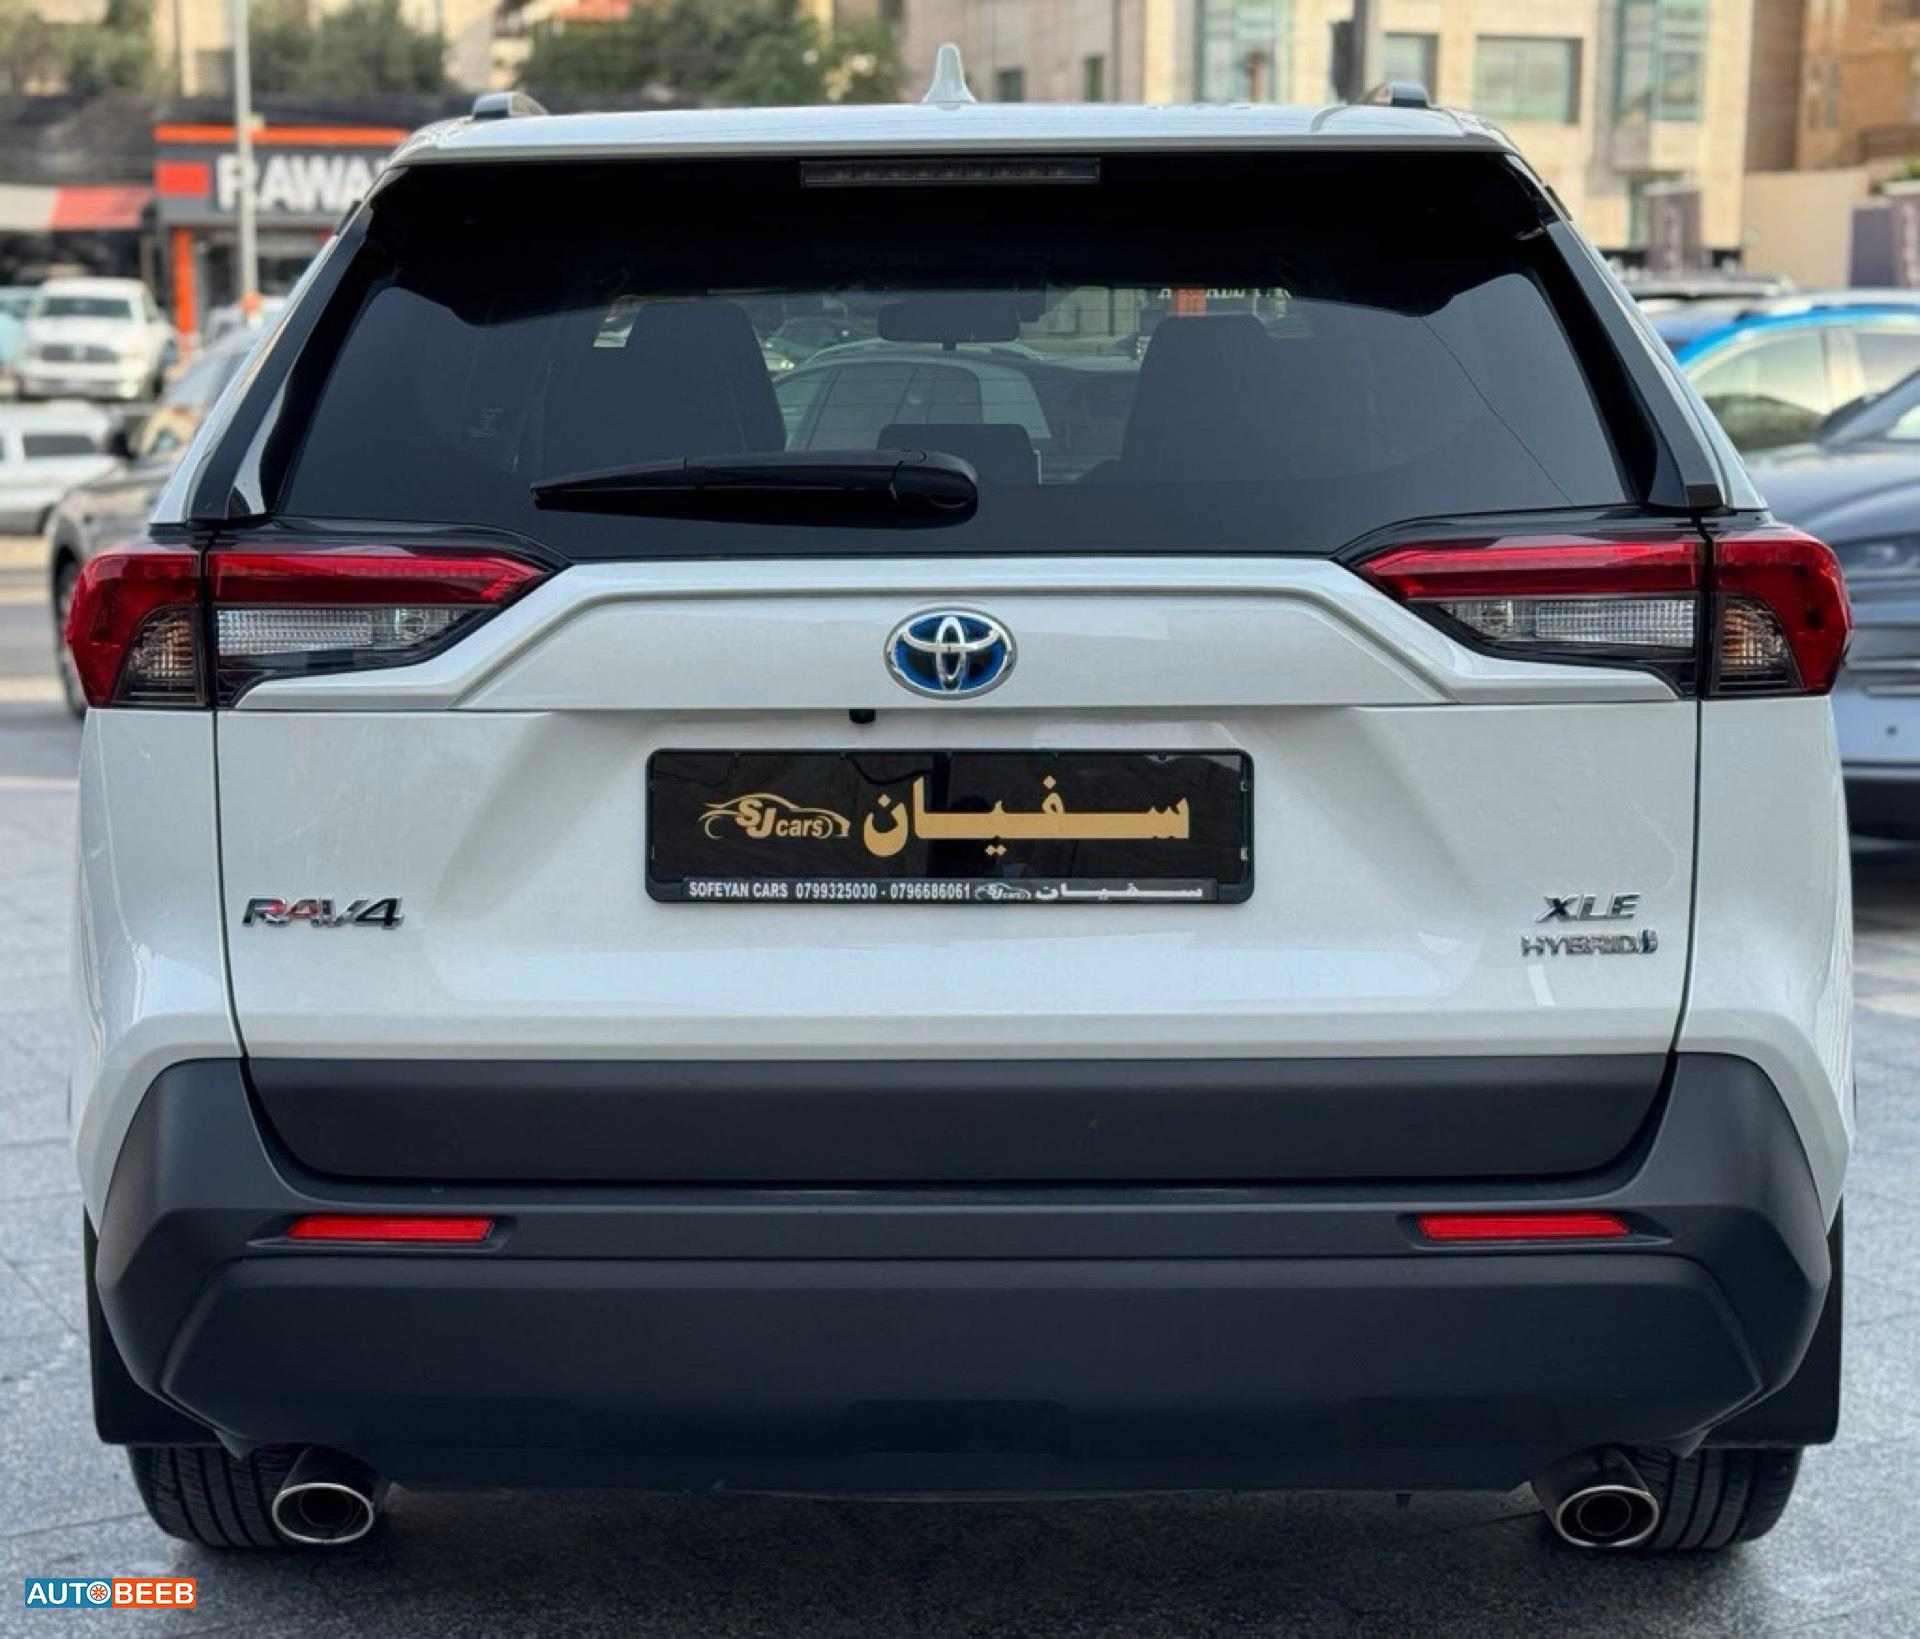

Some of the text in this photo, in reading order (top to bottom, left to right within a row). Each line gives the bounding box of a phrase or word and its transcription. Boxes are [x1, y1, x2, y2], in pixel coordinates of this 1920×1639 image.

[216, 153, 388, 210] RAWA
[776, 818, 824, 837] cars
[863, 776, 1190, 857] سفيان
[689, 881, 749, 897] SOFEYAN
[753, 882, 789, 898] CARS
[796, 882, 877, 899] 0799325030
[242, 896, 403, 930] RAV4
[1535, 893, 1641, 923] XLE
[1520, 934, 1638, 957] HYBRID
